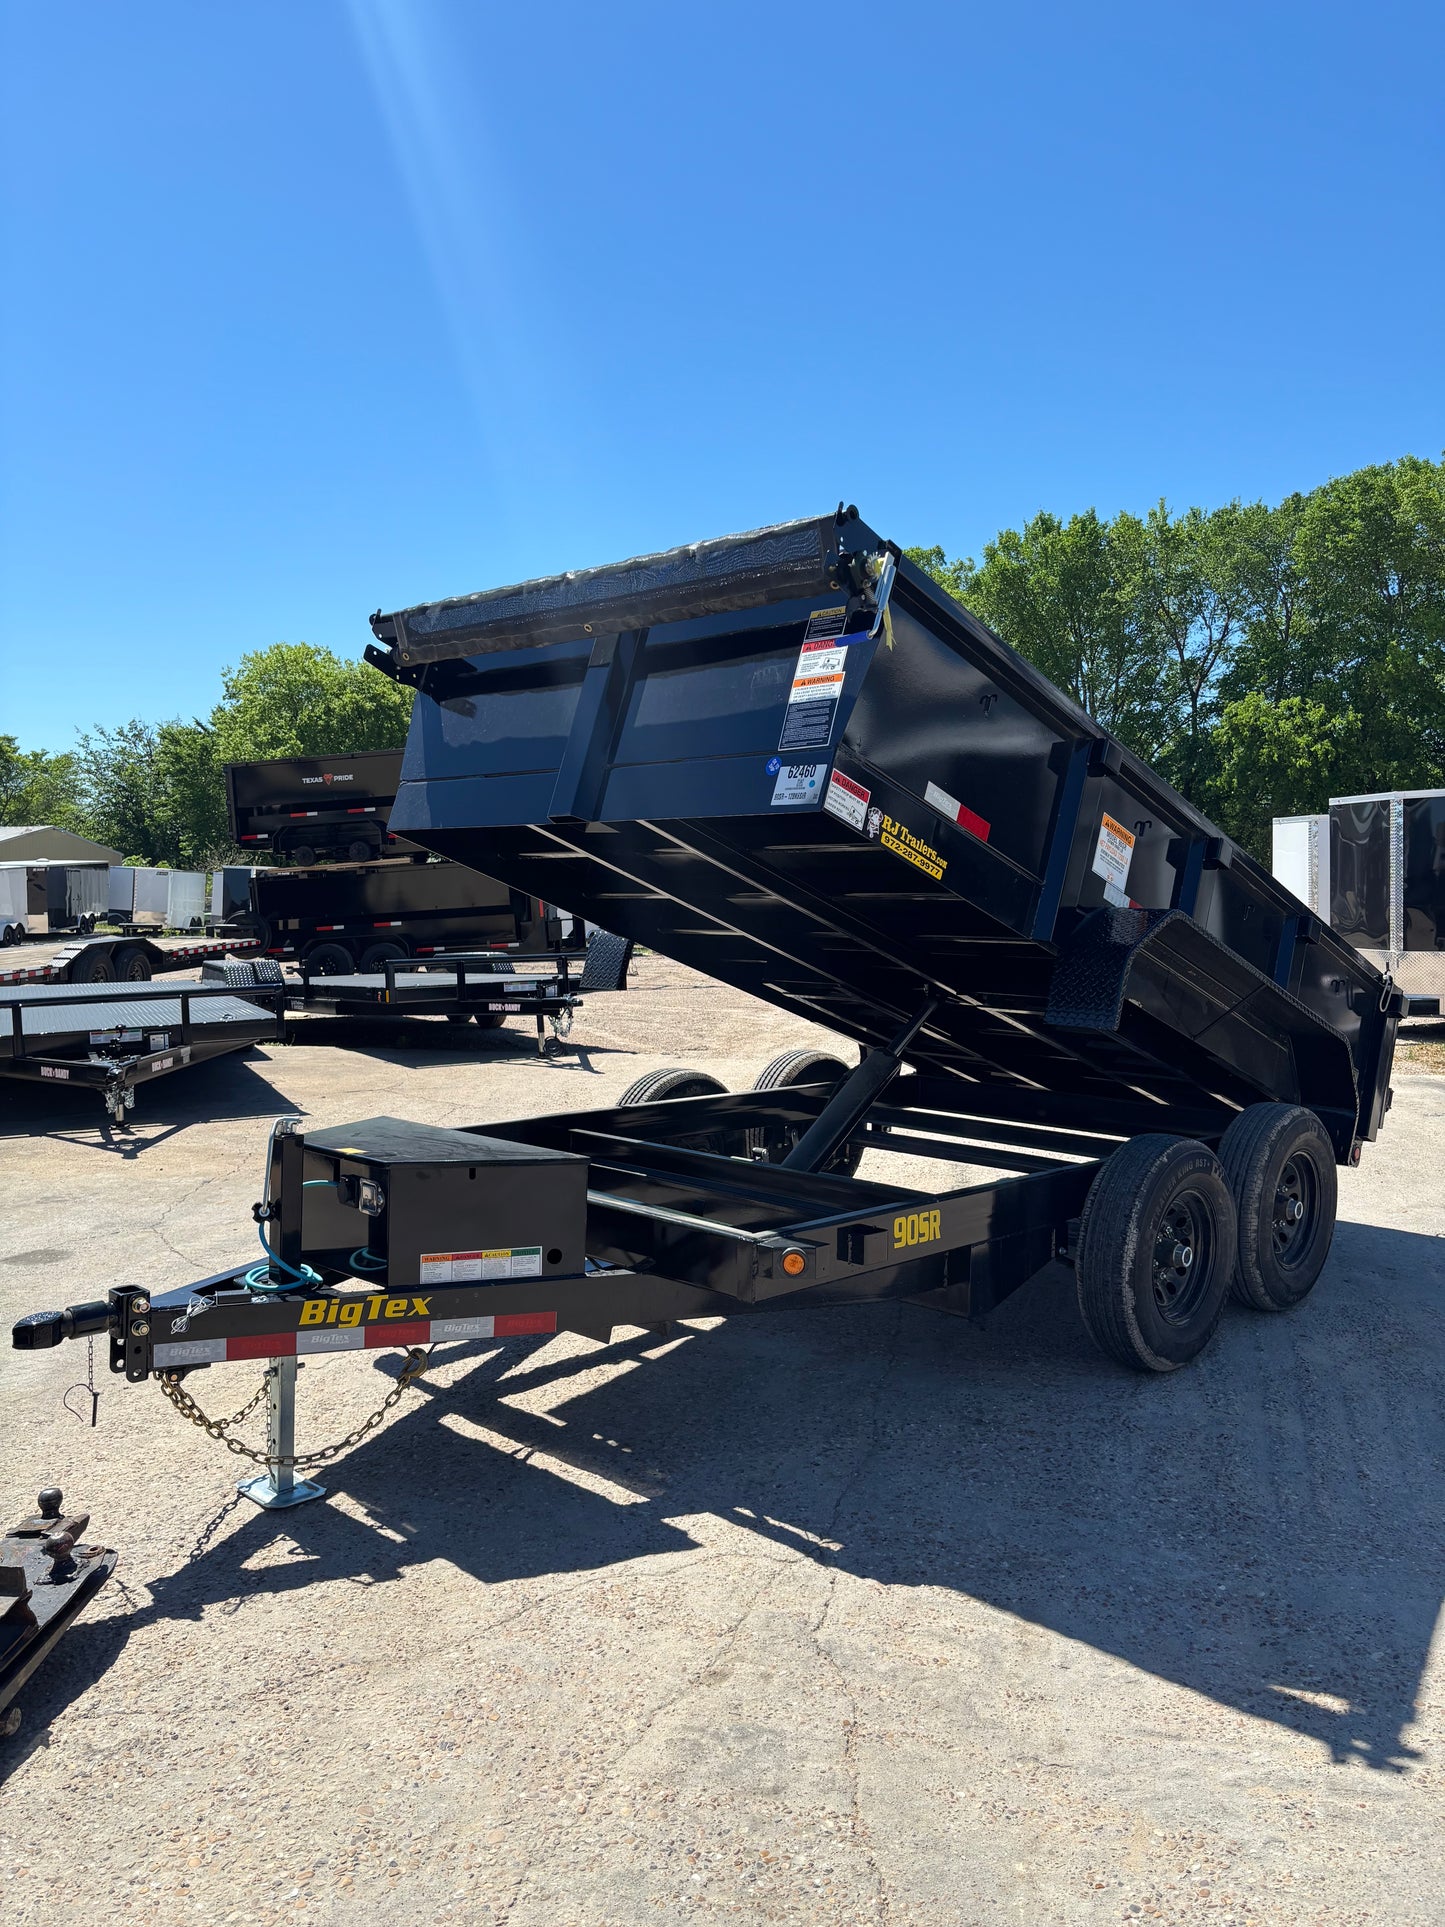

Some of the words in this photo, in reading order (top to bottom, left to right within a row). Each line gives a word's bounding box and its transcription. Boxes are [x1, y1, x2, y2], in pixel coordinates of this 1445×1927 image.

[814, 640, 834, 650] DANG
[807, 676, 835, 685] WARNING
[788, 765, 816, 778] 62460
[842, 779, 864, 798] DANGER
[882, 815, 900, 836] RJ
[1109, 824, 1131, 844] WARNING
[884, 835, 940, 875] 972-287-9977
[894, 1210, 941, 1248] 90SR
[299, 1295, 432, 1328] BigTex
